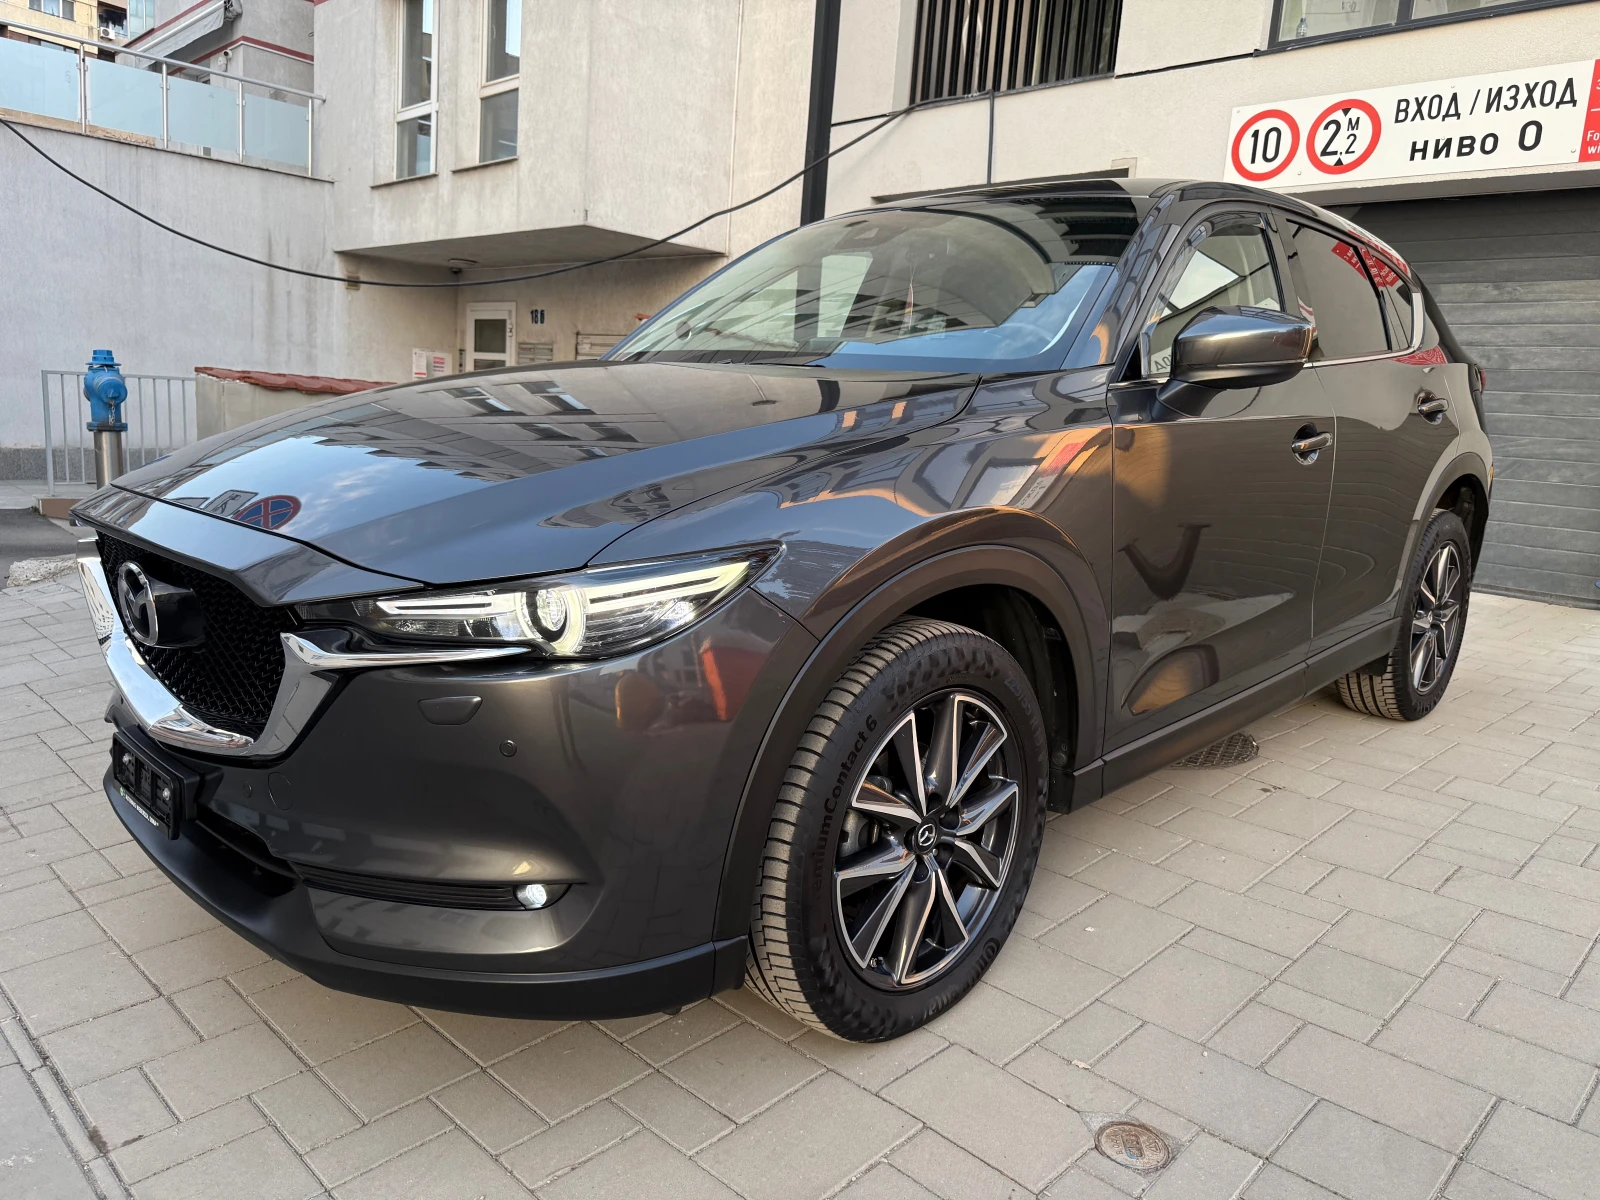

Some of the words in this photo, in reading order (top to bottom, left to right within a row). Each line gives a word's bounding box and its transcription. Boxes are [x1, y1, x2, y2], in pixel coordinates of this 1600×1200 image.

[1394, 92, 1461, 123] ВХОД
[1485, 77, 1577, 113] ИЗХОД
[1250, 127, 1282, 164] 10
[1409, 132, 1499, 161] ниво
[865, 714, 878, 732] 6
